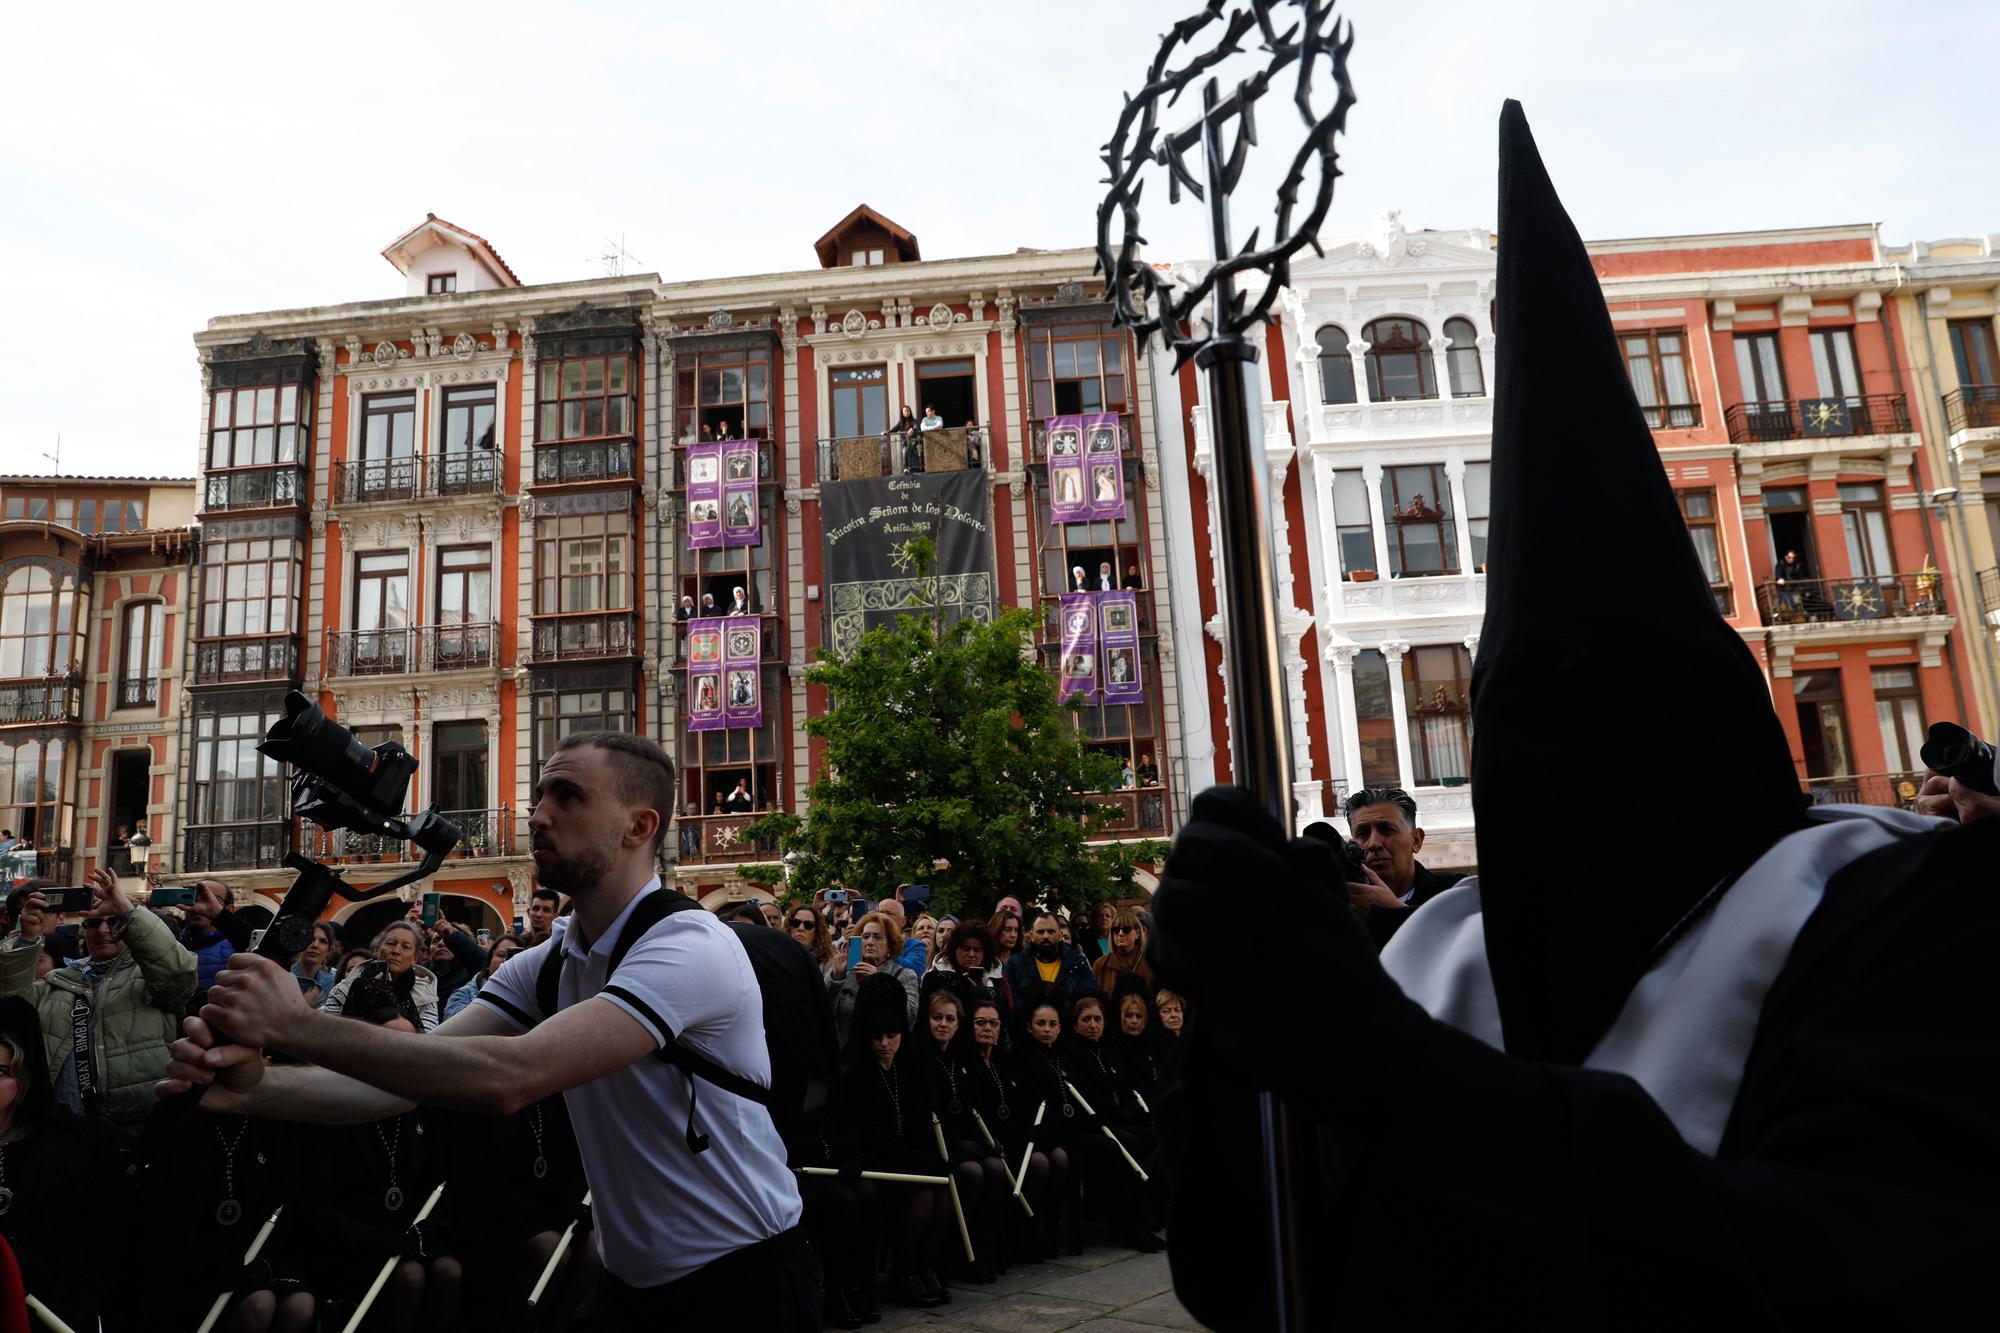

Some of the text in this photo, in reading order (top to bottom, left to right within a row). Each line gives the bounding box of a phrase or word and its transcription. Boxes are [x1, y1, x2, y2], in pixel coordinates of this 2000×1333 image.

[901, 492, 909, 500] de
[825, 502, 986, 546] Nuestra Señora de los Dolores
